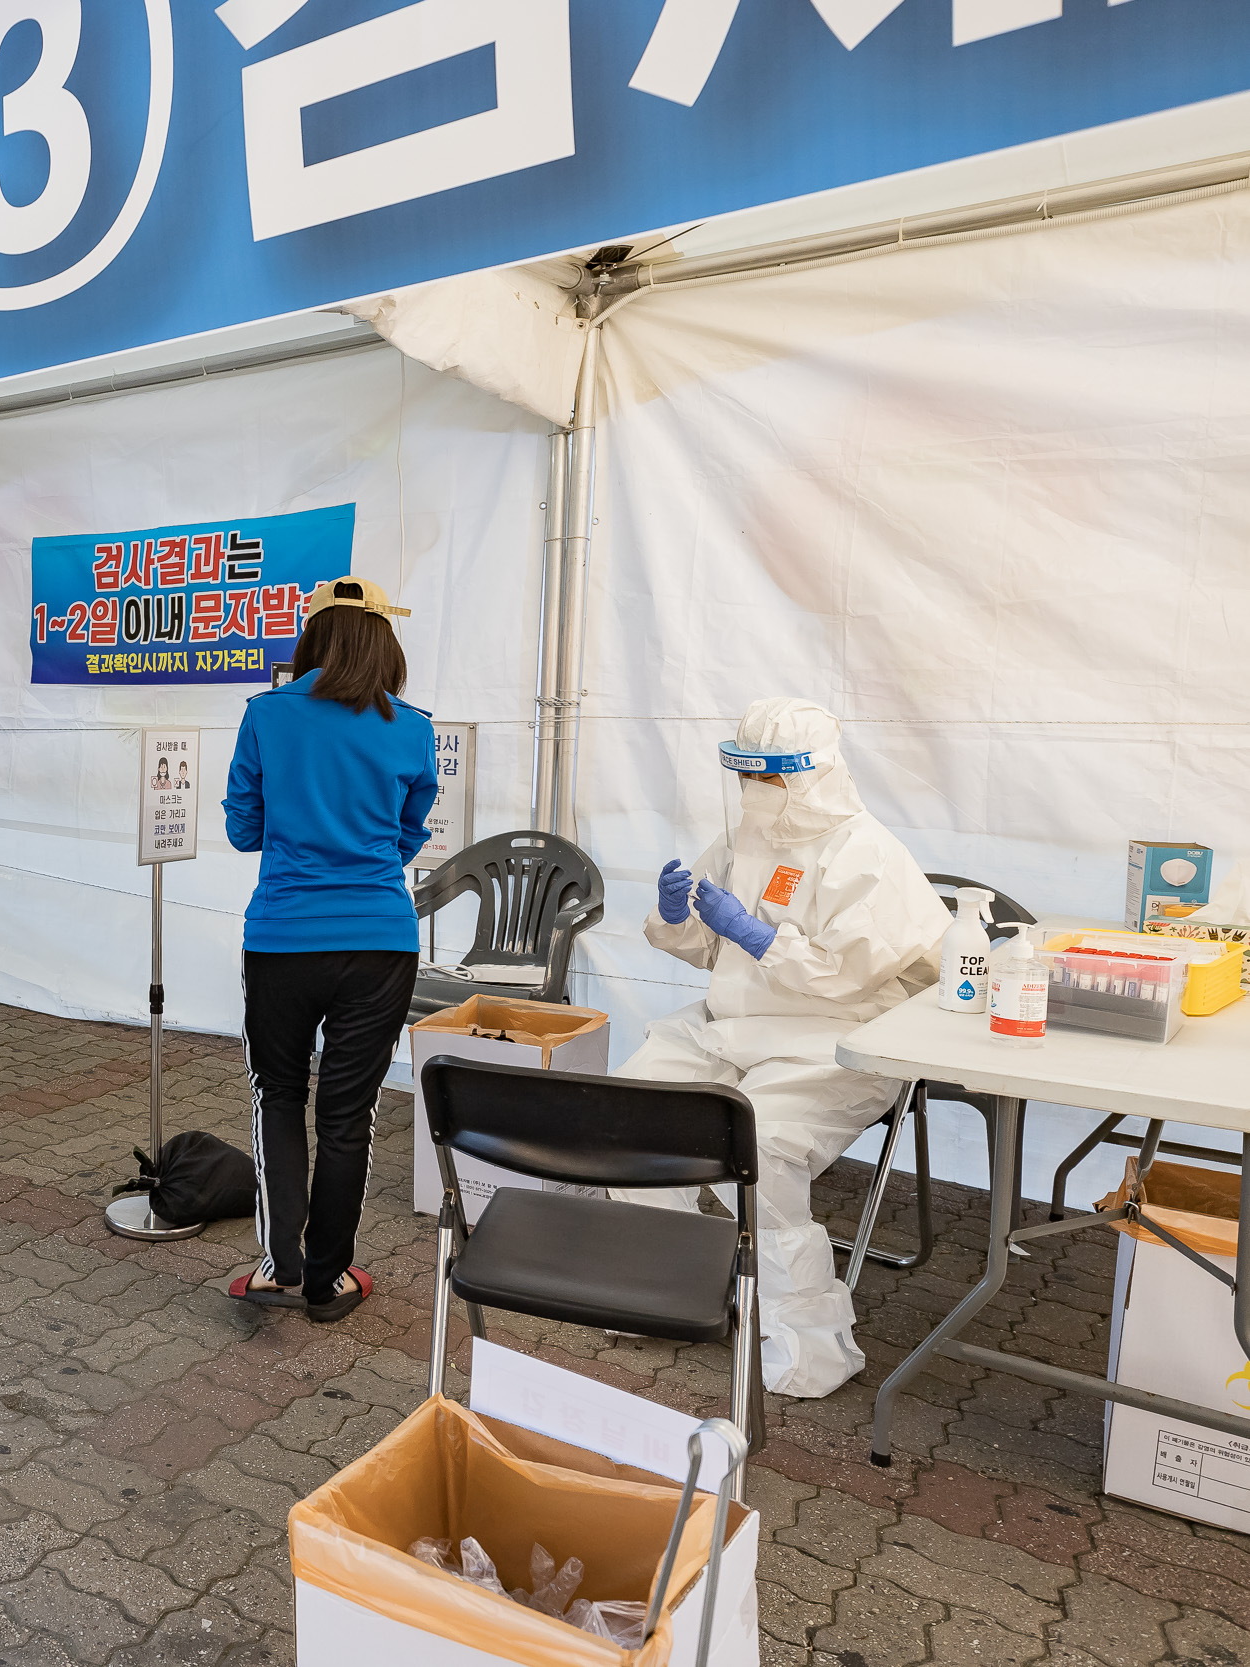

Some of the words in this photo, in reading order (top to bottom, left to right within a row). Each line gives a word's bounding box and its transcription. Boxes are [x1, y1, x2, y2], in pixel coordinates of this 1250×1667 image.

[92, 530, 264, 592] 검사결과는
[85, 650, 189, 675] 결과확인시까지
[194, 648, 265, 673] 자가격리
[155, 741, 179, 752] 검사받을
[733, 758, 762, 767] SHIELD
[159, 794, 183, 805] 마스크는
[169, 808, 186, 819] 가리고
[427, 818, 449, 826] 운영시간
[154, 837, 184, 849] 내려주세요
[960, 955, 985, 966] TOP
[959, 966, 990, 976] CLEA
